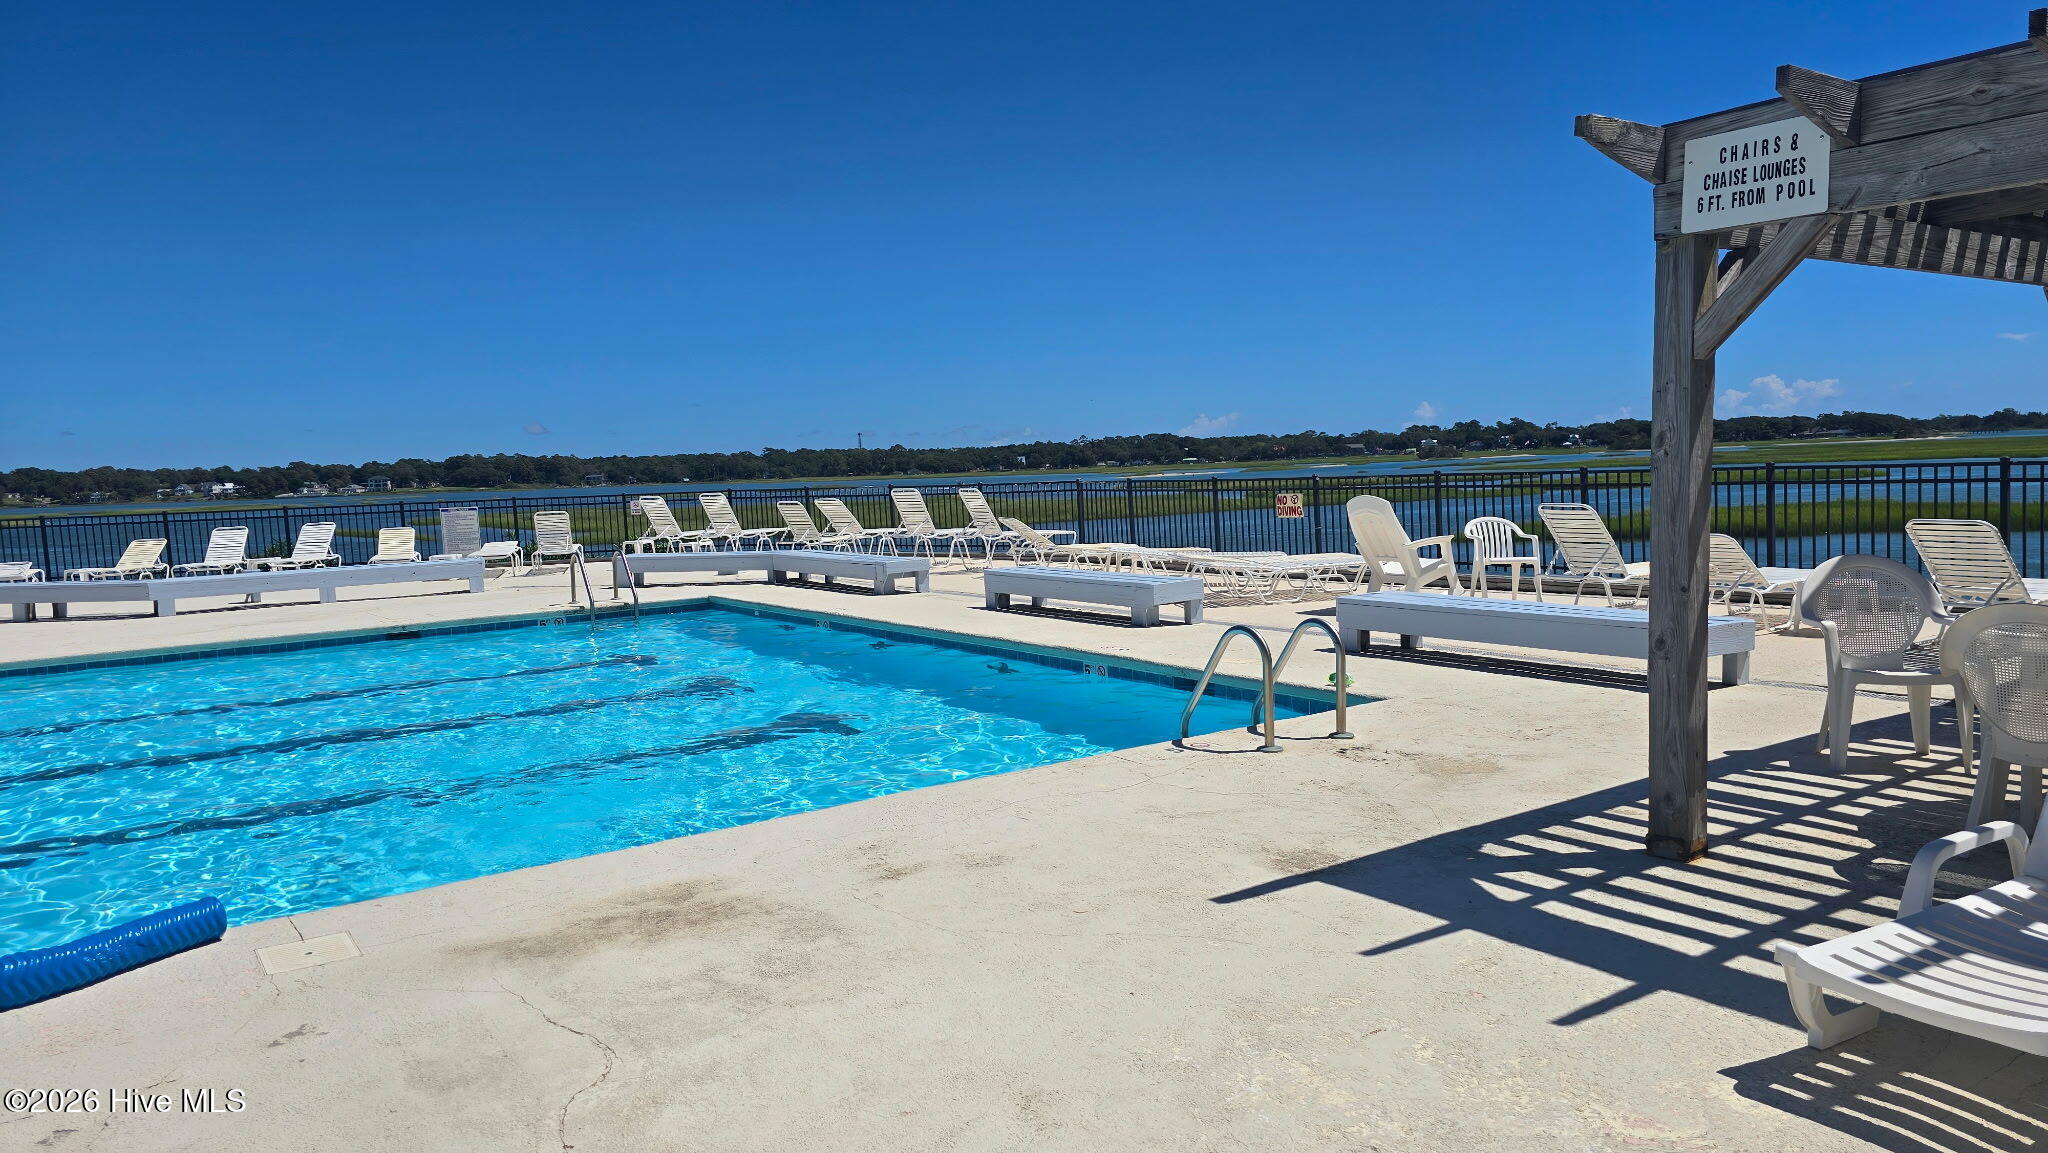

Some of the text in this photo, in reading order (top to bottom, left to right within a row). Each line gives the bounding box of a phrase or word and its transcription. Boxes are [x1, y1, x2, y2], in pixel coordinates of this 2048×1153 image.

[1720, 133, 1799, 164] CHAIRS &
[1703, 156, 1806, 191] CHAISE LOUNGES
[1697, 179, 1816, 213] 6 FT. FROM POOL
[1277, 495, 1287, 505] NO
[1278, 506, 1302, 516] DIVING
